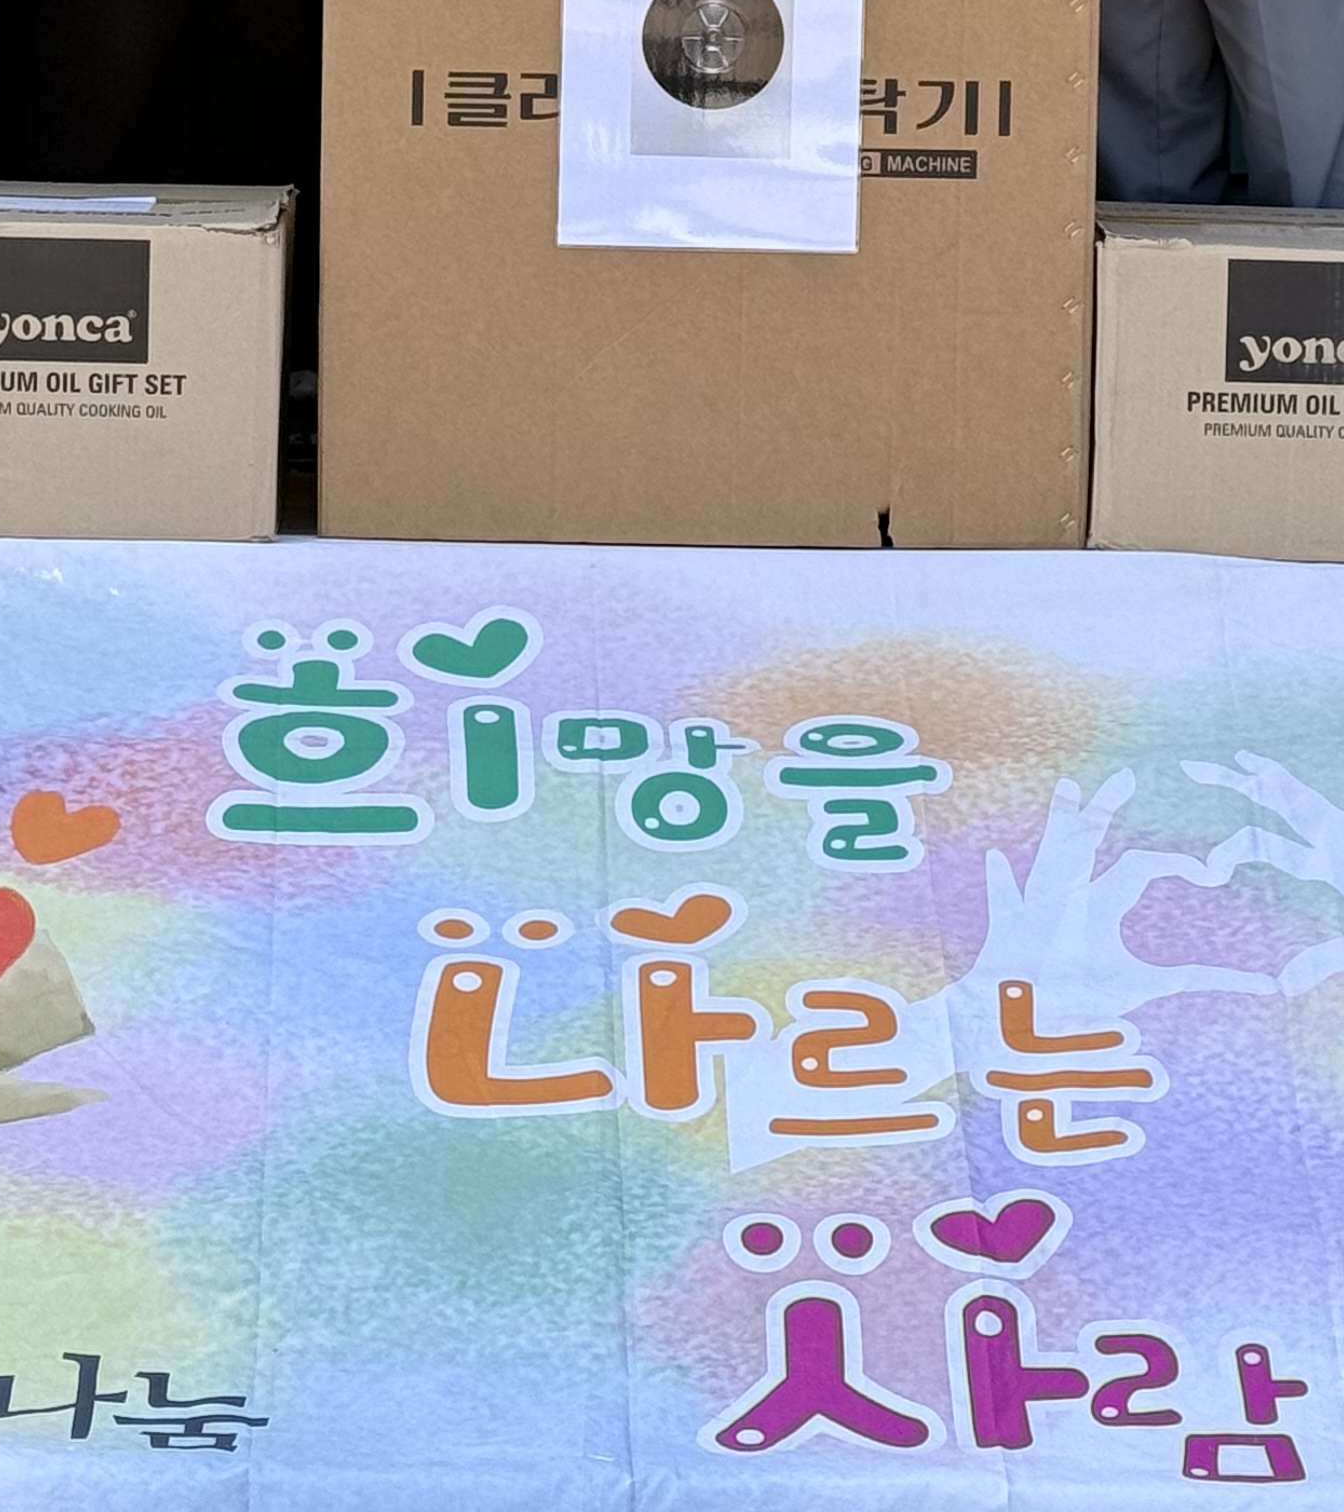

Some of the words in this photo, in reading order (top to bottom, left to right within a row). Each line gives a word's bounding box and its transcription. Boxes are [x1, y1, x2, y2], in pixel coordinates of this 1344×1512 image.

[886, 155, 973, 174] MACHINE
[46, 372, 81, 394] OIL
[88, 373, 138, 395] GIFT
[144, 374, 187, 396] SET
[16, 401, 75, 418] QUALITY
[79, 403, 142, 419] COOKING
[146, 404, 167, 419] OIL
[1187, 392, 1298, 415] PREMIUM
[1305, 394, 1340, 416] OIL
[1204, 422, 1272, 438] PREMIUM
[1276, 423, 1334, 440] QUALITY
[222, 628, 939, 862] 희망을
[426, 938, 1154, 1154] 나르는
